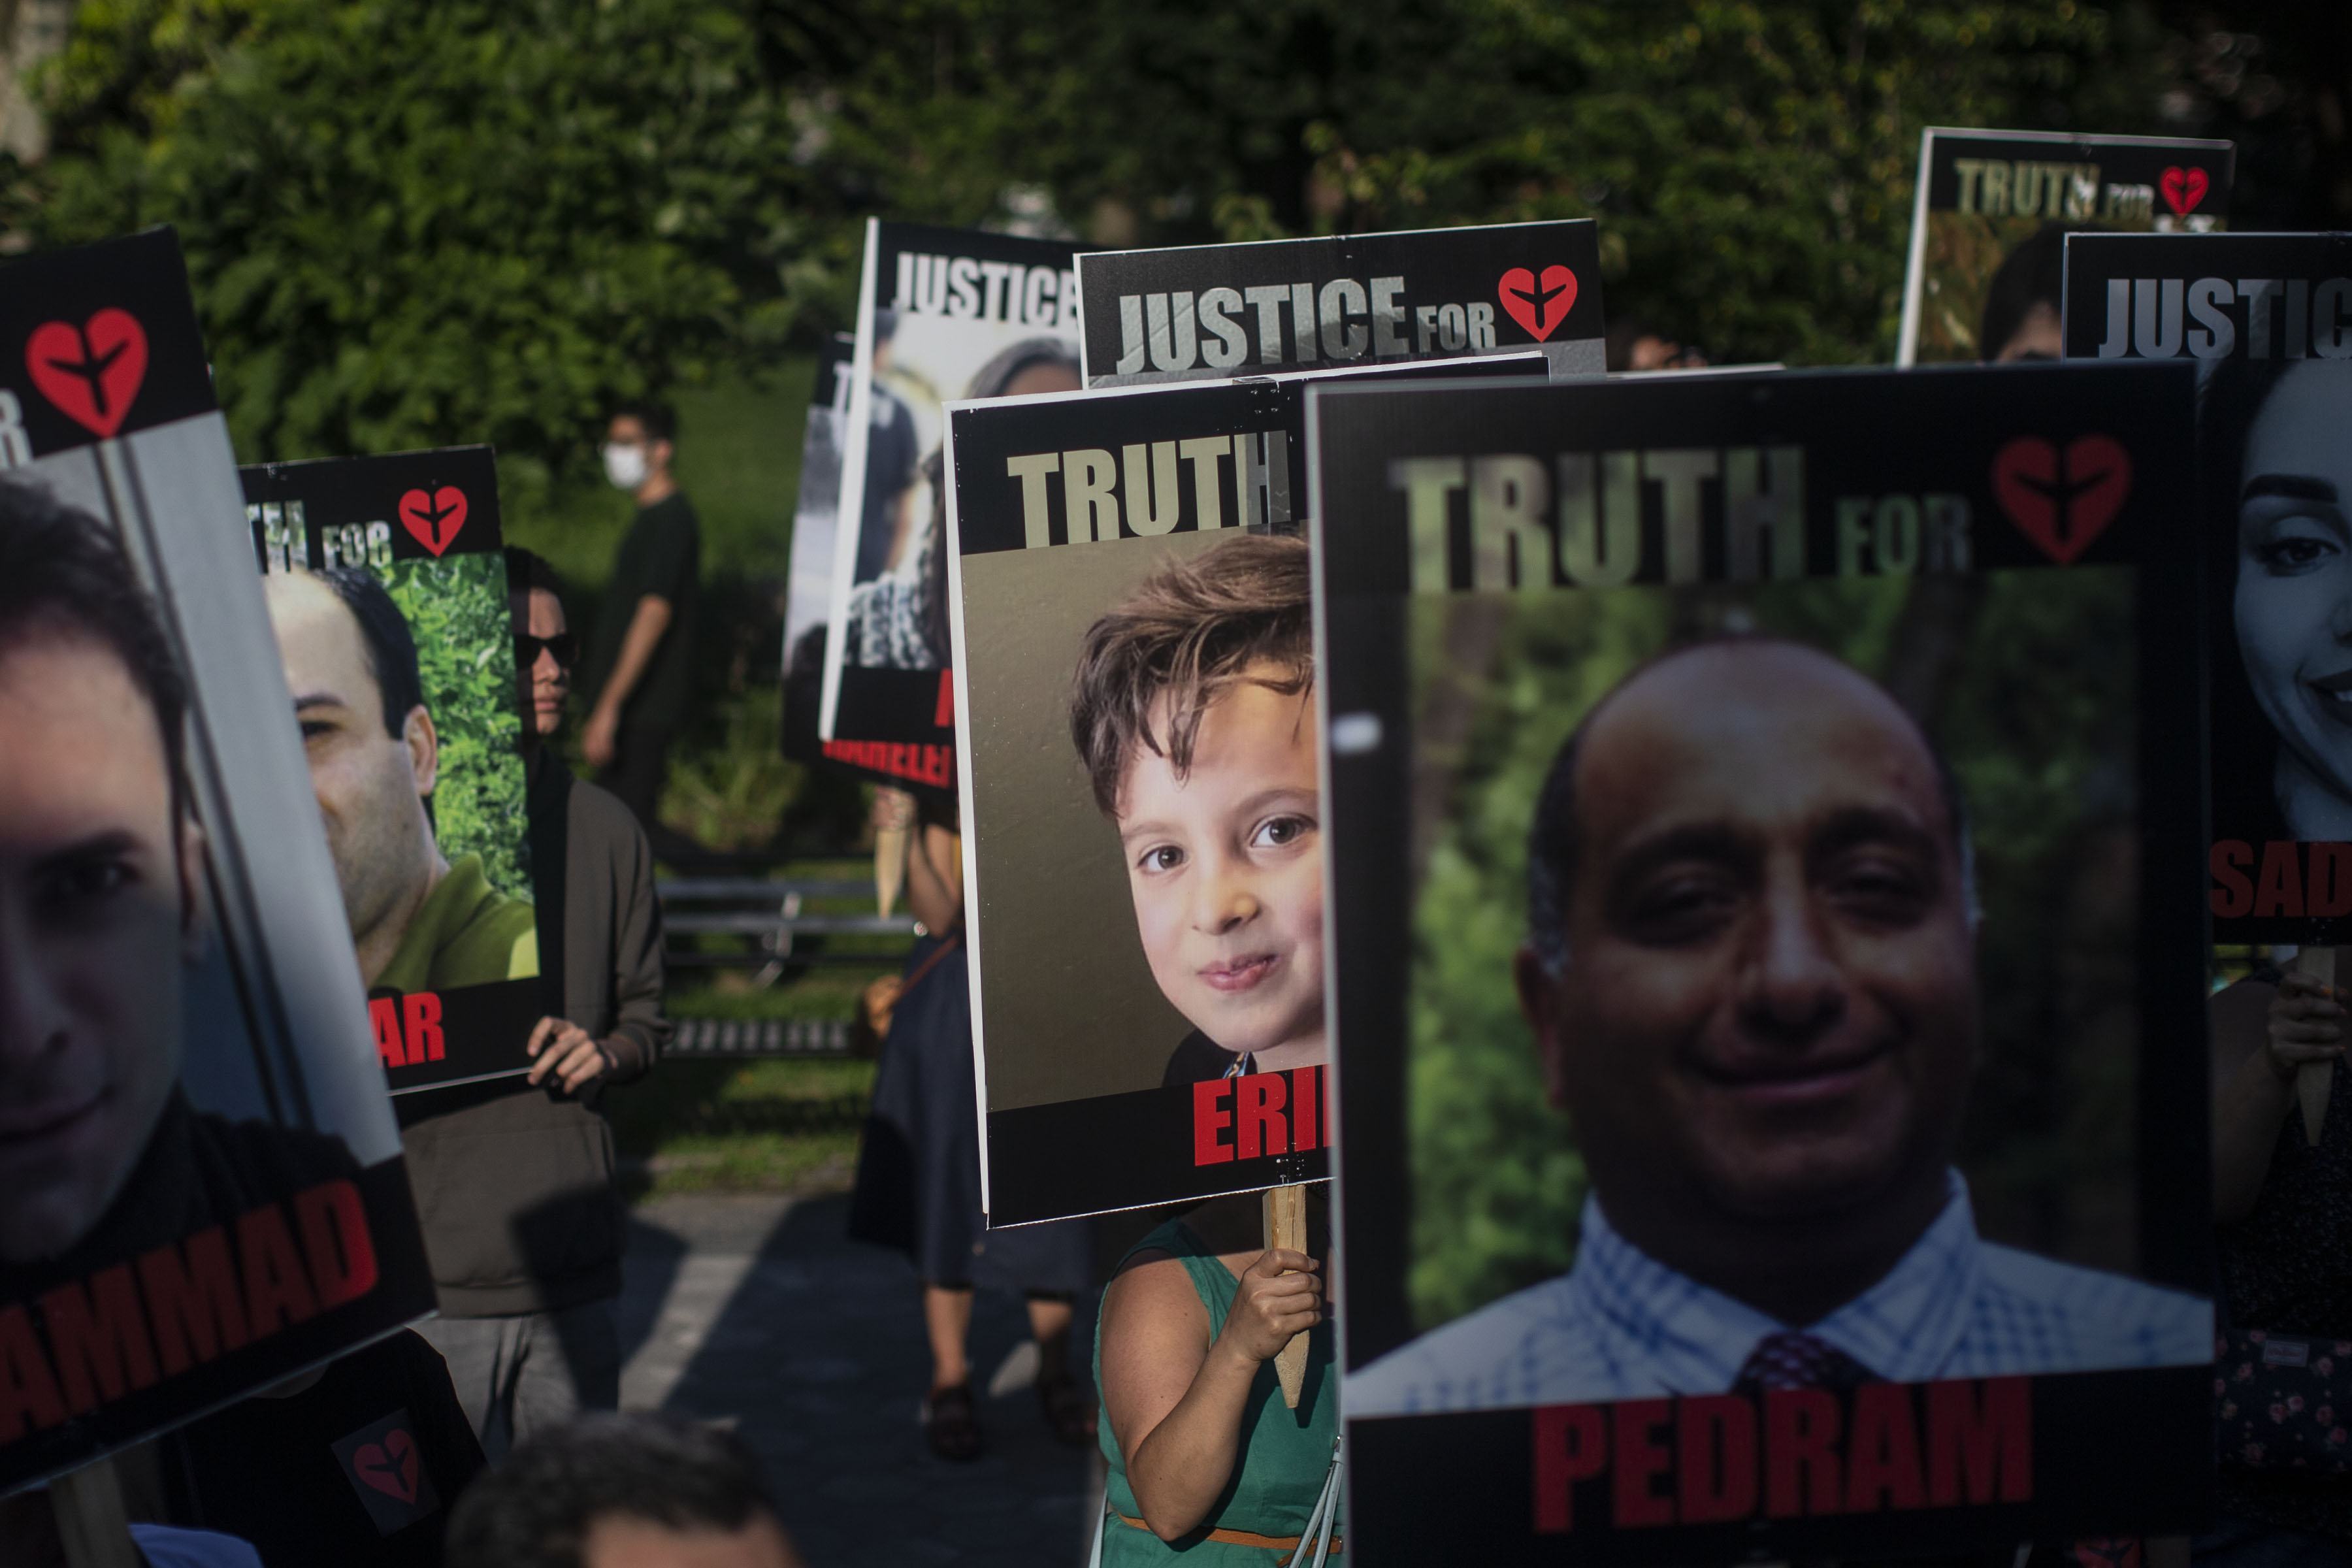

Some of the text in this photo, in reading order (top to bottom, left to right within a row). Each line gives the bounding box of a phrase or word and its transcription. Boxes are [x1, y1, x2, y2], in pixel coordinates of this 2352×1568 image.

[1954, 158, 2101, 219] TRUTH
[890, 251, 1077, 327] JUSTICE
[1117, 276, 1497, 376] JUSTICE FOR
[2099, 277, 2352, 359] JUSTIC
[1007, 430, 1292, 549] TRUTH
[1388, 445, 1974, 595] TRUTH FOR
[321, 520, 394, 570] FOR
[2209, 839, 2352, 919] SAD
[0, 1179, 379, 1446] AMMAD
[1530, 1376, 2034, 1535] PEDRAM
